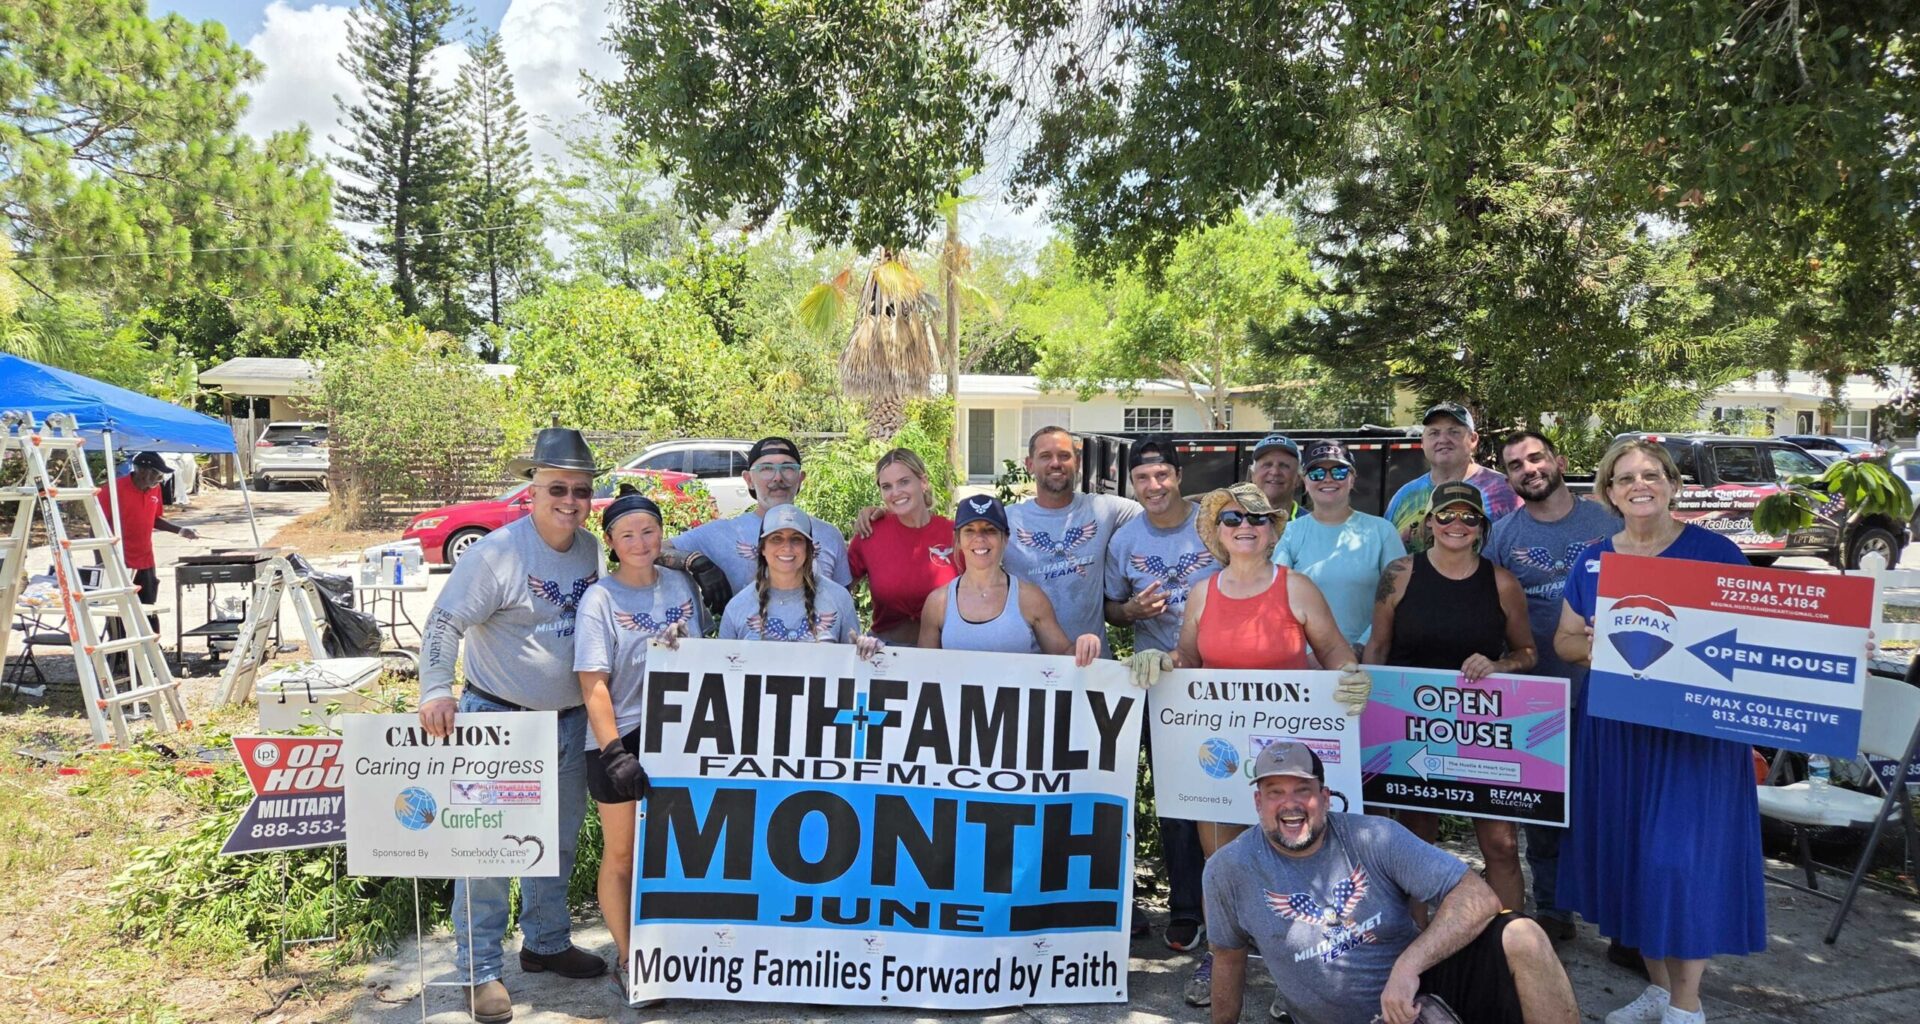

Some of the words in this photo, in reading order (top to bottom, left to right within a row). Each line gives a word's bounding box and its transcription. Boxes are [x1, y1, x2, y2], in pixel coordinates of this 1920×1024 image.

[1028, 561, 1070, 576] MILITARY
[1044, 566, 1077, 580] TEAM
[1717, 577, 1772, 592] REGINA
[1777, 583, 1826, 598] TYLER
[1721, 589, 1819, 610] 727.945.4184
[1614, 614, 1671, 634] RE/MAX
[1704, 645, 1763, 666] OPEN
[1771, 654, 1849, 675] HOUSE
[1187, 681, 1311, 703] CAUTION:
[1414, 685, 1502, 717] OPEN
[1684, 692, 1741, 711] RE/MAX
[1746, 702, 1839, 725] COLLECTIVE
[644, 671, 855, 759] FAITH
[866, 679, 1136, 772] FAMILY
[1160, 708, 1222, 731] Caring
[1229, 710, 1246, 728] in
[1253, 711, 1346, 733] Progress
[1712, 709, 1807, 733] 813.438.7841
[1406, 716, 1513, 750] HOUSE
[257, 750, 275, 762] lpt
[355, 757, 421, 780] Caring
[427, 757, 444, 775] in
[452, 757, 545, 779] Progress
[699, 756, 1071, 793] FANDFM.COM
[1178, 793, 1220, 805] Sponsored
[1222, 797, 1233, 807] By
[1386, 782, 1475, 803] 813-563-1573
[1490, 788, 1542, 804] RE/MAX
[1490, 798, 1534, 809] COLLECTIVE
[258, 796, 342, 819] MILITARY
[441, 807, 503, 829] CareFest
[641, 786, 1125, 894] MONTH
[372, 849, 416, 859] Sponsored
[418, 849, 429, 859] By
[451, 847, 499, 858] Somebody
[780, 895, 985, 932] JUNE
[1294, 928, 1353, 962] MILITARY
[1356, 912, 1382, 935] VET
[1321, 935, 1364, 963] TEAM
[634, 946, 744, 993] Moving
[753, 950, 872, 991] Families
[881, 955, 1001, 995] Forward
[1009, 956, 1042, 998] by
[1051, 950, 1117, 988] Faith
